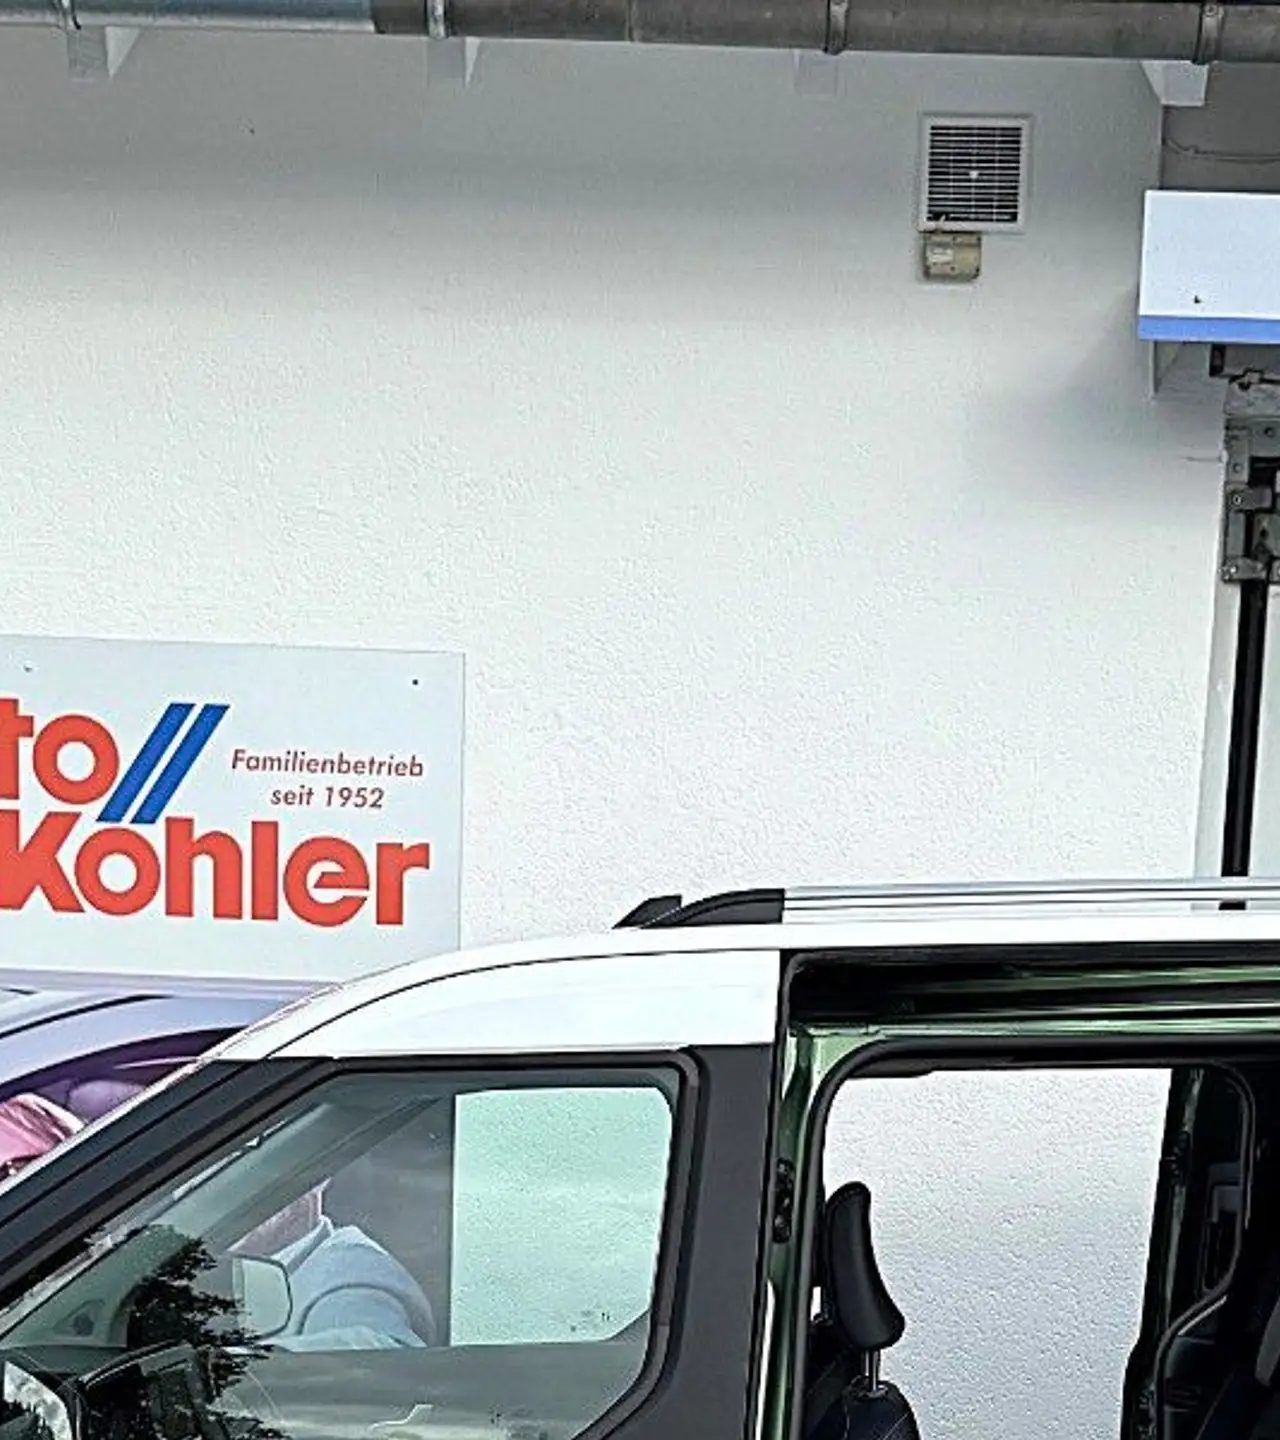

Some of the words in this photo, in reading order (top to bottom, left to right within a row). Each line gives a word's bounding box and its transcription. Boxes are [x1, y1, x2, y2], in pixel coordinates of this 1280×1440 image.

[232, 749, 423, 776] Familienbetrieb
[271, 785, 314, 805] seit
[326, 787, 384, 808] 1952
